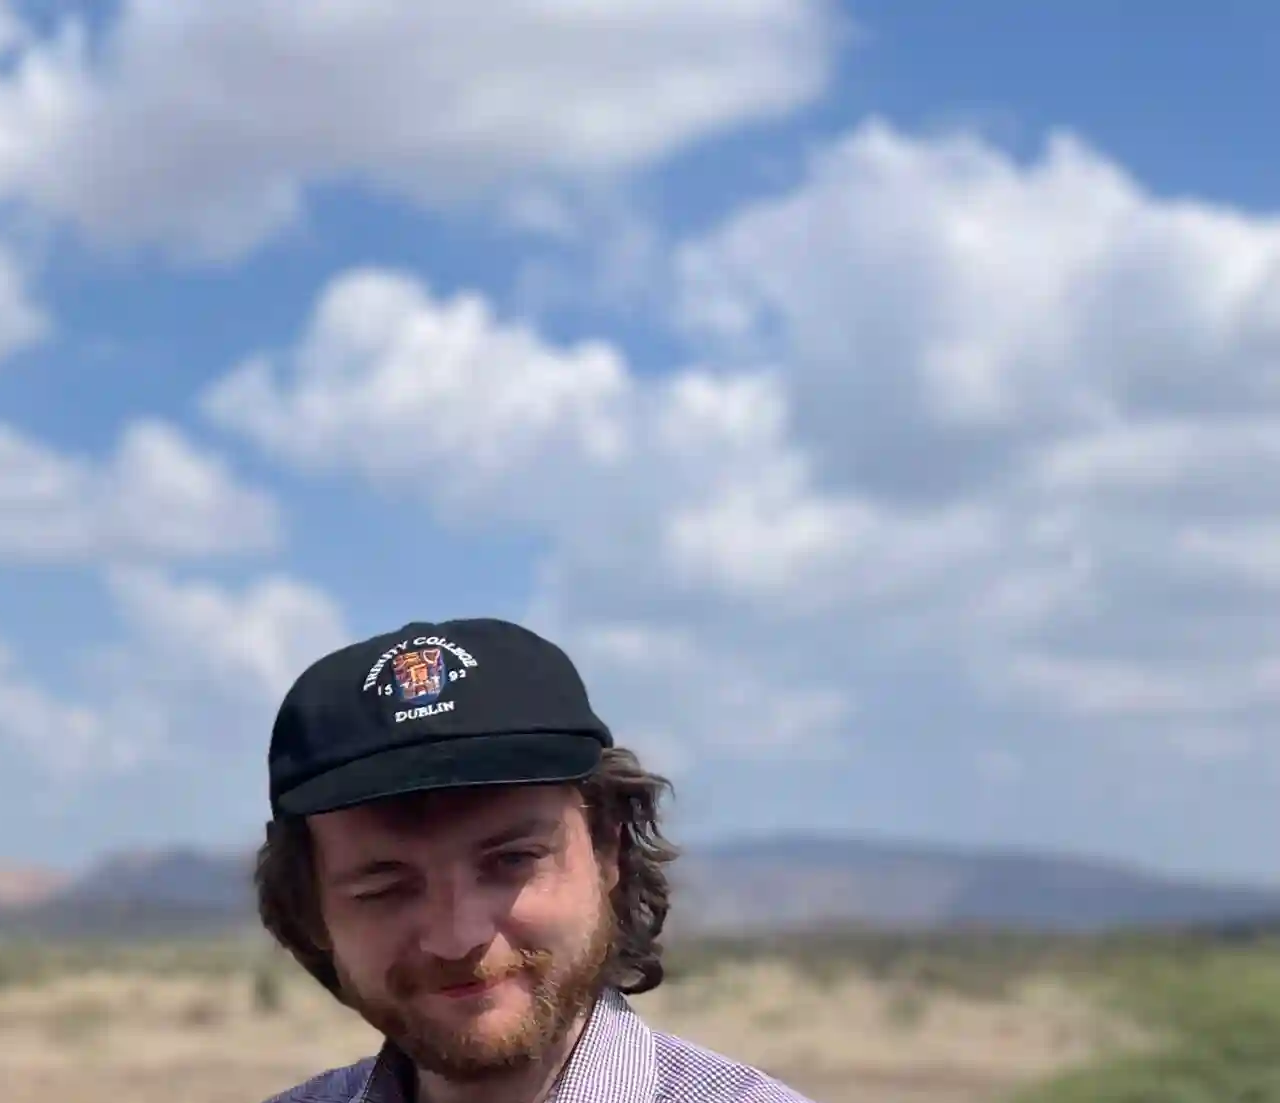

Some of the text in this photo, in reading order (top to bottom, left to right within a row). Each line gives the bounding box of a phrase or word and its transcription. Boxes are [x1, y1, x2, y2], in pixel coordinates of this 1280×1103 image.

[377, 669, 467, 696] 15 92
[394, 700, 455, 723] DUBLIN
